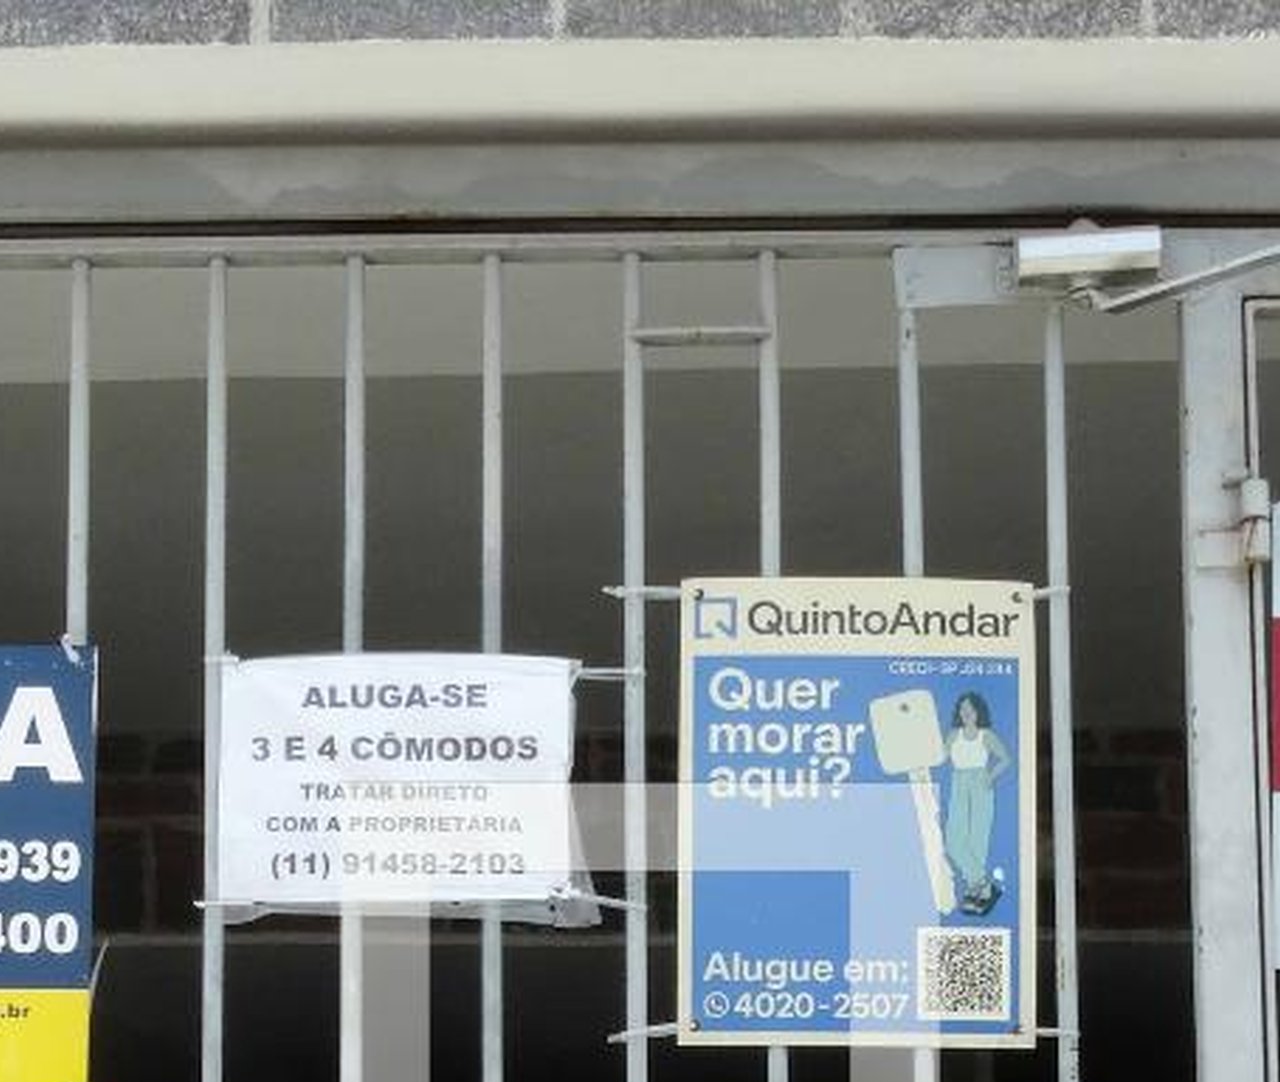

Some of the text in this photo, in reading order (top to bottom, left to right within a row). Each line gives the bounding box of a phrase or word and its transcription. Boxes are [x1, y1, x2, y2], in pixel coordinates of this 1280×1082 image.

[747, 601, 1019, 638] QuintoAndar
[302, 683, 488, 709] ALUGA-SE
[708, 667, 840, 711] Quer
[252, 732, 539, 762] 3 E 4 CÔMODOS
[708, 722, 866, 755] morar
[300, 783, 488, 801] TRATAR DIRETO
[708, 757, 851, 808] aqui?
[266, 816, 318, 832] COM
[325, 816, 341, 832] A
[271, 852, 525, 880] (11) 91458-2103
[703, 951, 908, 990] Alugue em:
